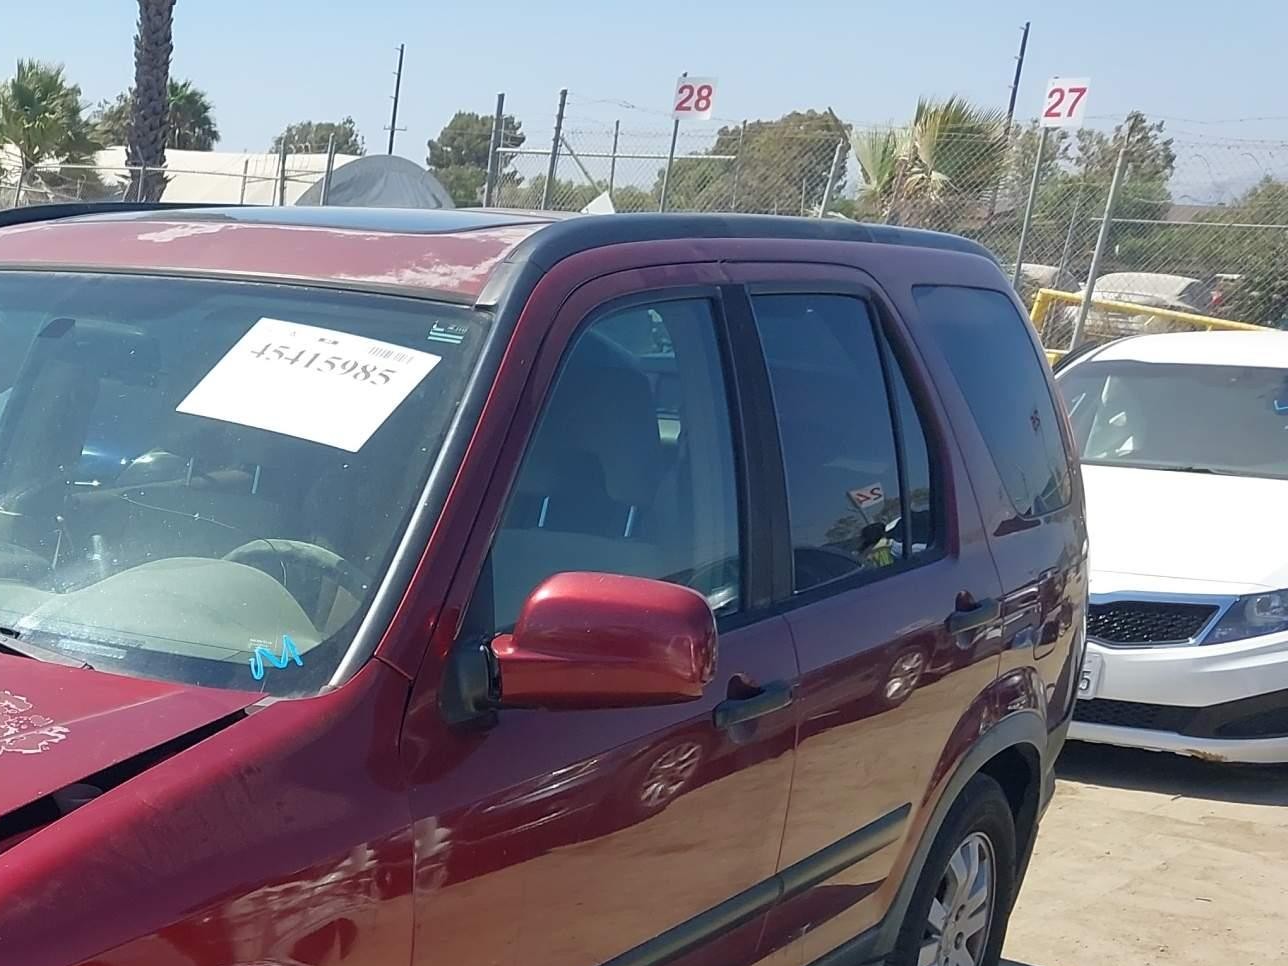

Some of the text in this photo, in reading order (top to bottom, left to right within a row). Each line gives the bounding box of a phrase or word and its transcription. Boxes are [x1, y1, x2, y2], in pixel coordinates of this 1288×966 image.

[675, 84, 713, 112] 28
[1044, 87, 1087, 118] 27
[250, 342, 397, 385] 45415985
